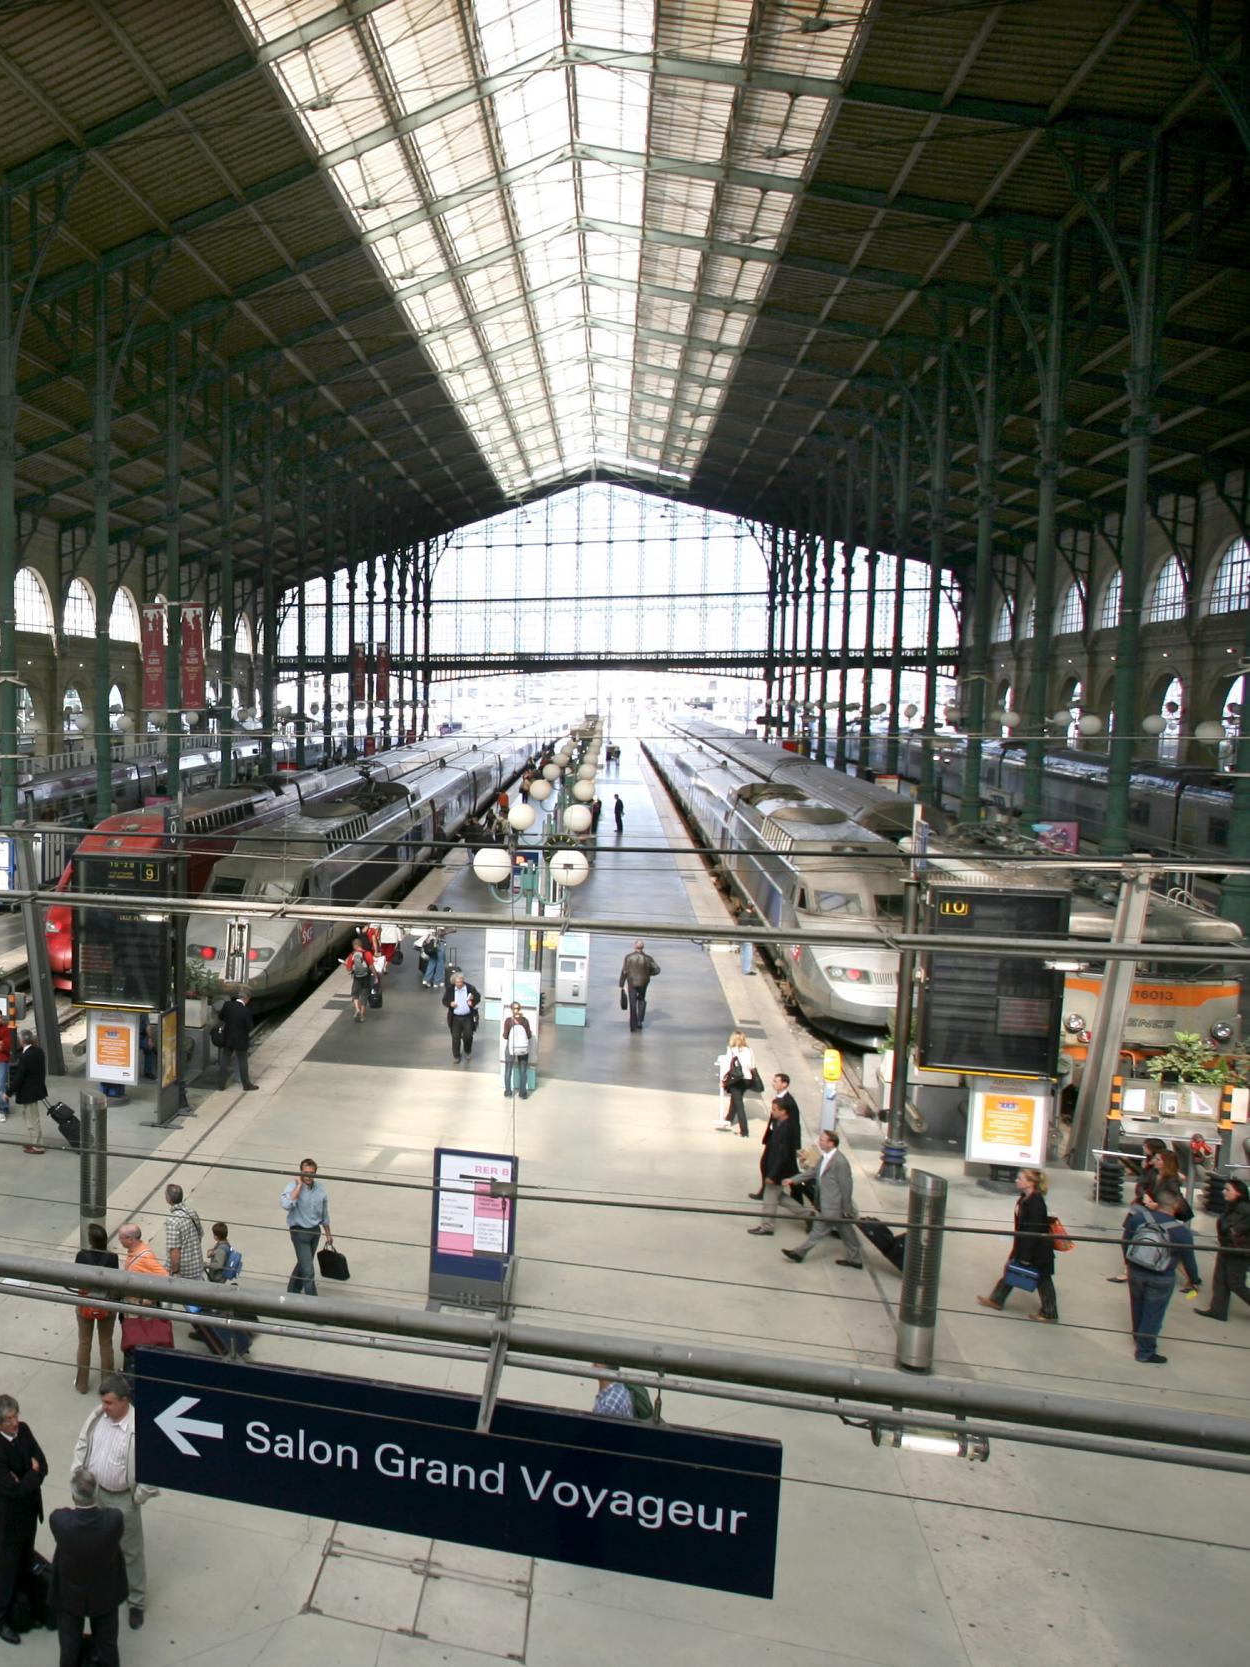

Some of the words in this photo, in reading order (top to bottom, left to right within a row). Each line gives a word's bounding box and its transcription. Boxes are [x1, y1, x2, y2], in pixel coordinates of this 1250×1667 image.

[145, 869, 154, 880] 9
[1134, 990, 1174, 1000] 16013
[474, 1165, 499, 1176] RER
[244, 1419, 359, 1471] Salon
[374, 1442, 506, 1496] Grand
[519, 1465, 749, 1536] Voyageur
